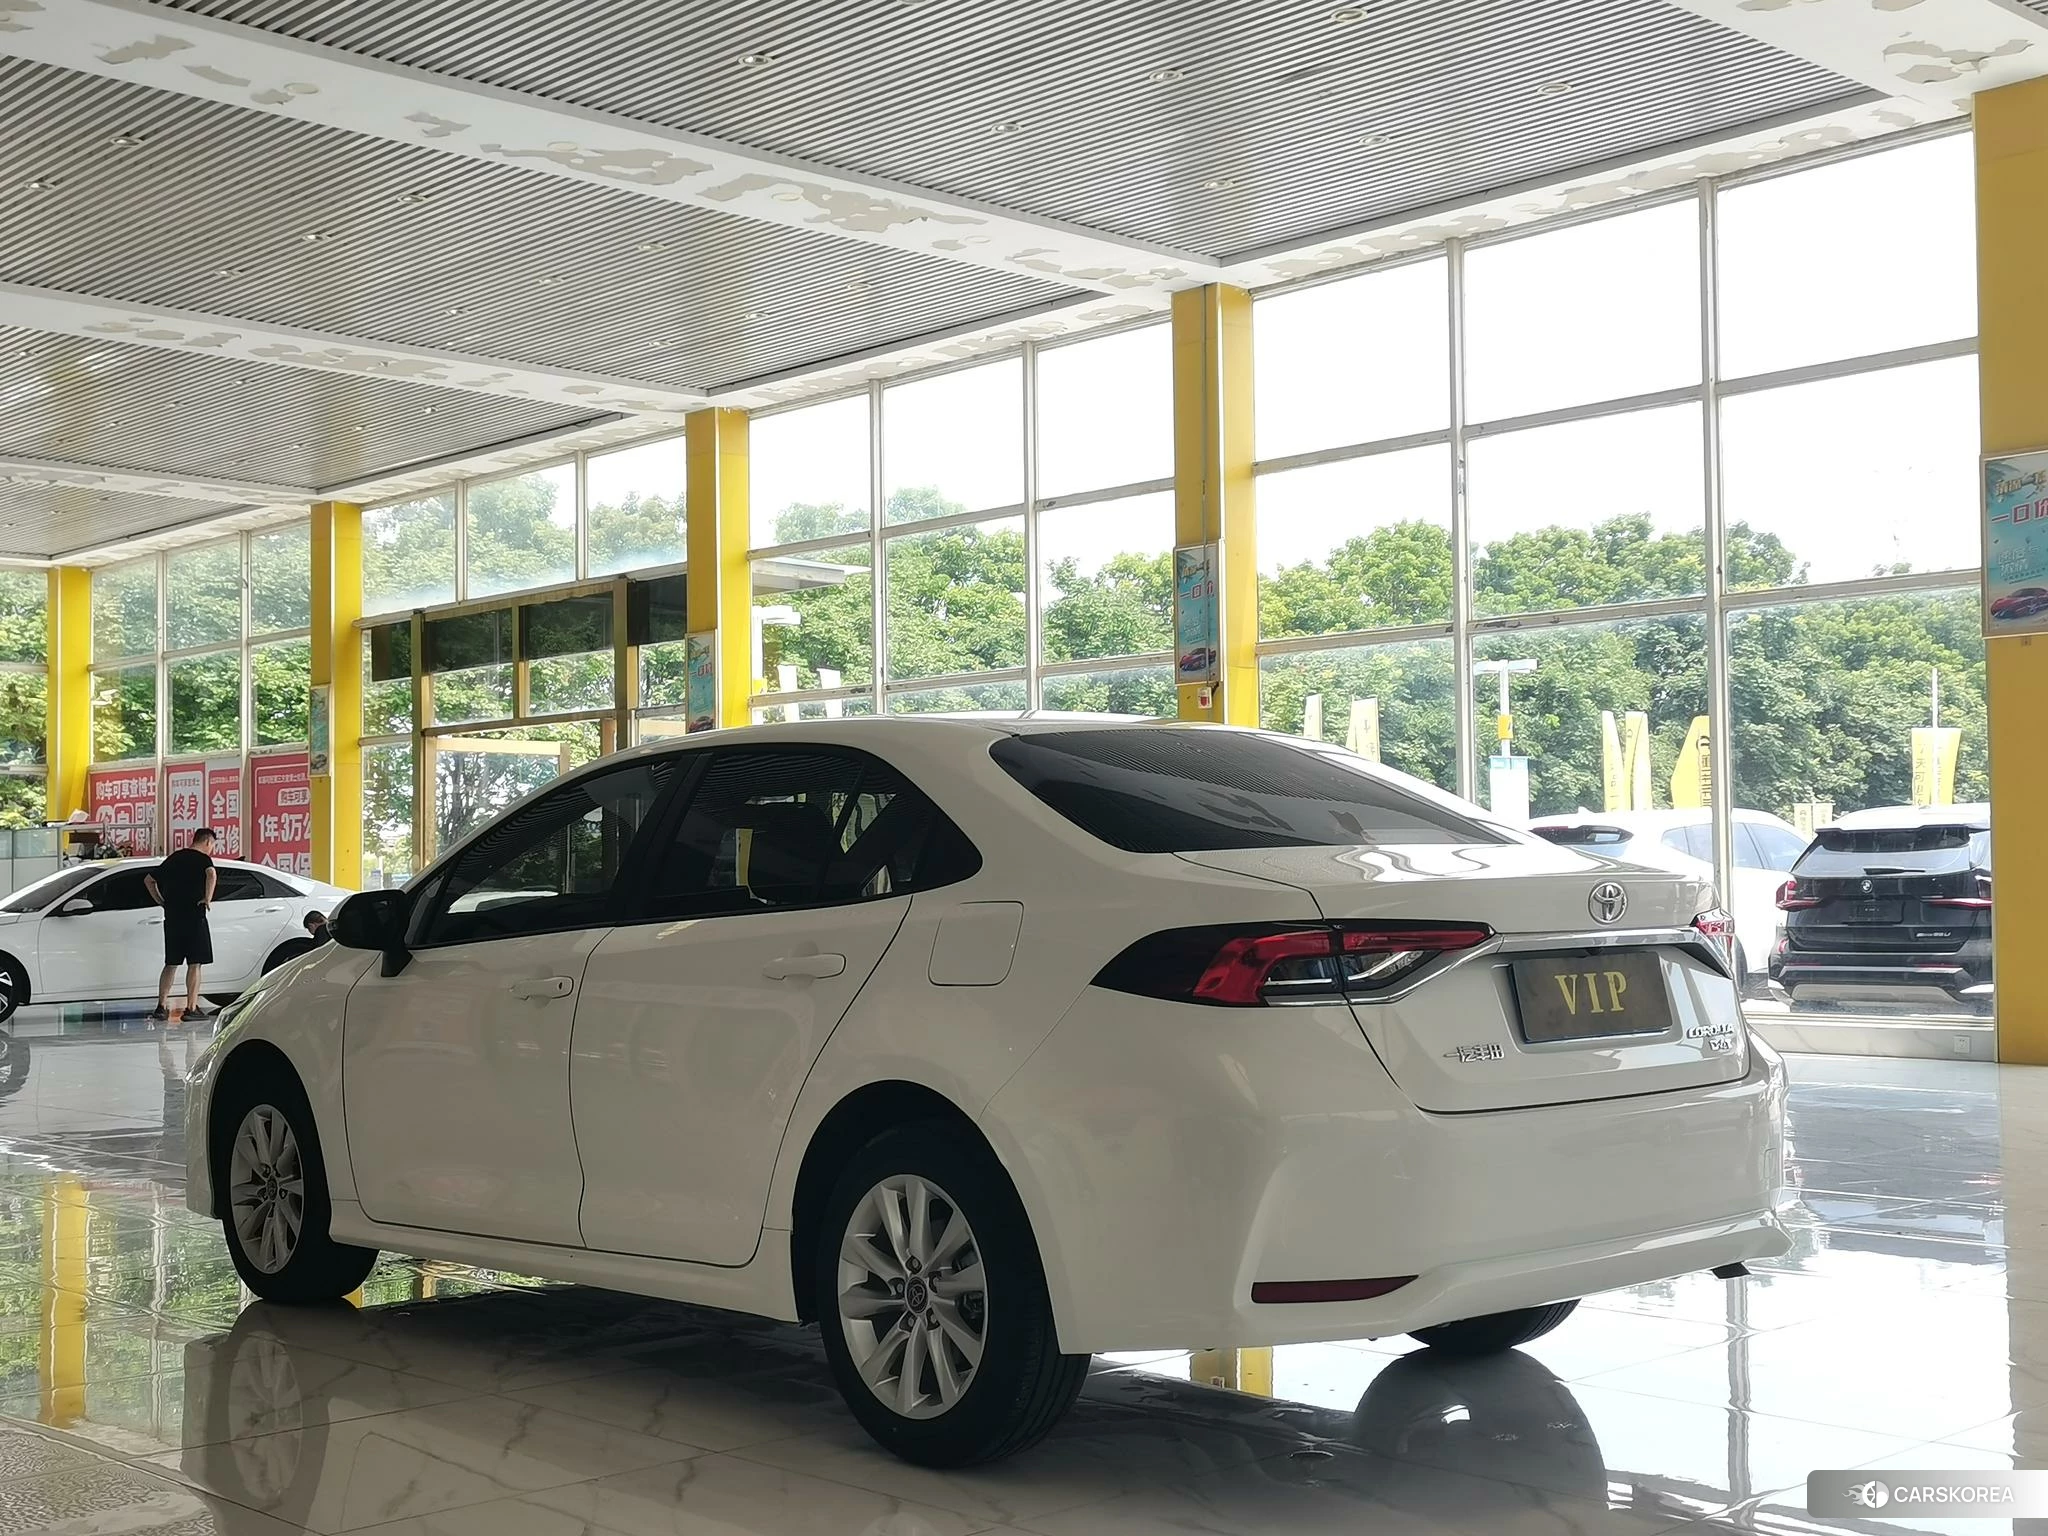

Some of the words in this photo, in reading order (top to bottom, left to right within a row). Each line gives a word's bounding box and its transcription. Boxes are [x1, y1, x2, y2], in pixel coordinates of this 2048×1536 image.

[95, 776, 156, 801] 购车可享查博士
[173, 792, 199, 820] 终身
[211, 789, 239, 819] 全国
[1554, 971, 1628, 1015] VIP
[1443, 1044, 1504, 1062] 一汽丰田
